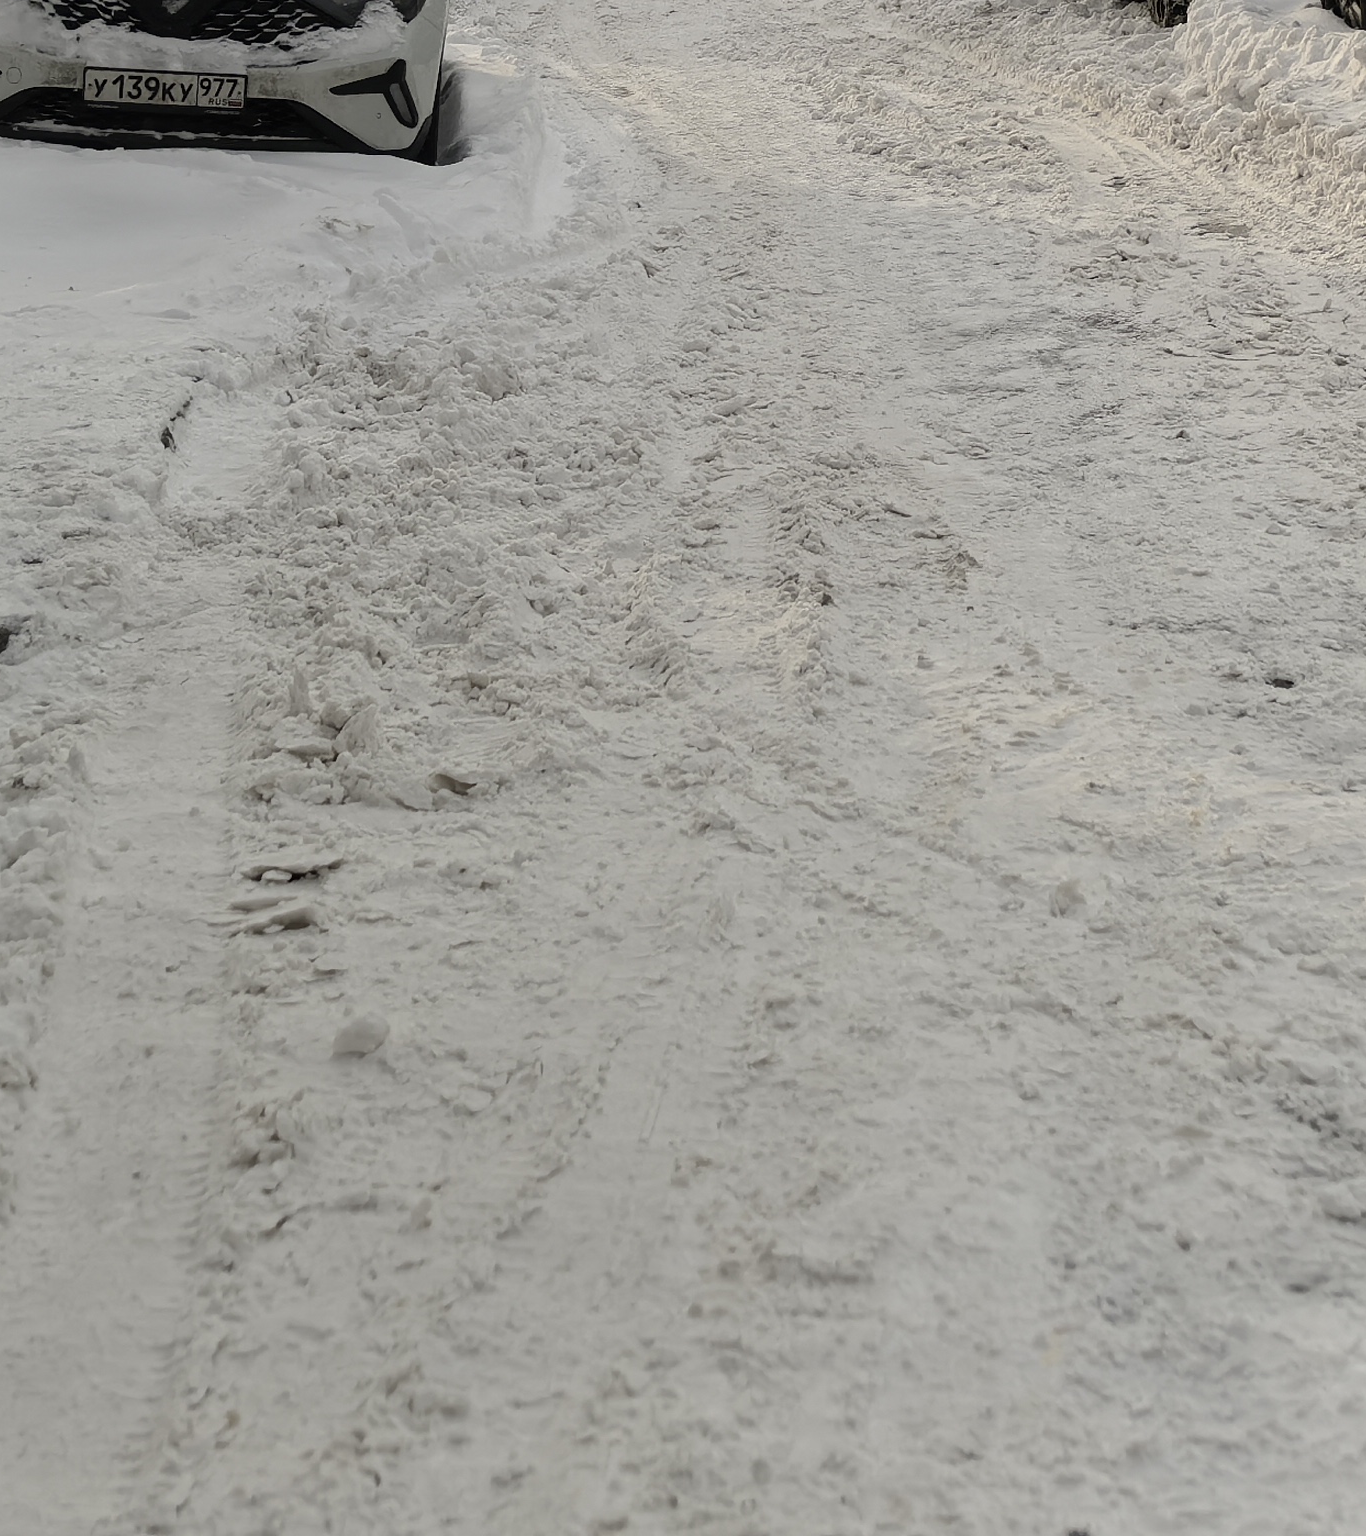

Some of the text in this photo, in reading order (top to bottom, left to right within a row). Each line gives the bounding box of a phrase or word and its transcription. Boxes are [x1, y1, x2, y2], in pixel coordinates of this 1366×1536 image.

[94, 74, 238, 103] У139КУ 977
[208, 97, 228, 107] RUS
